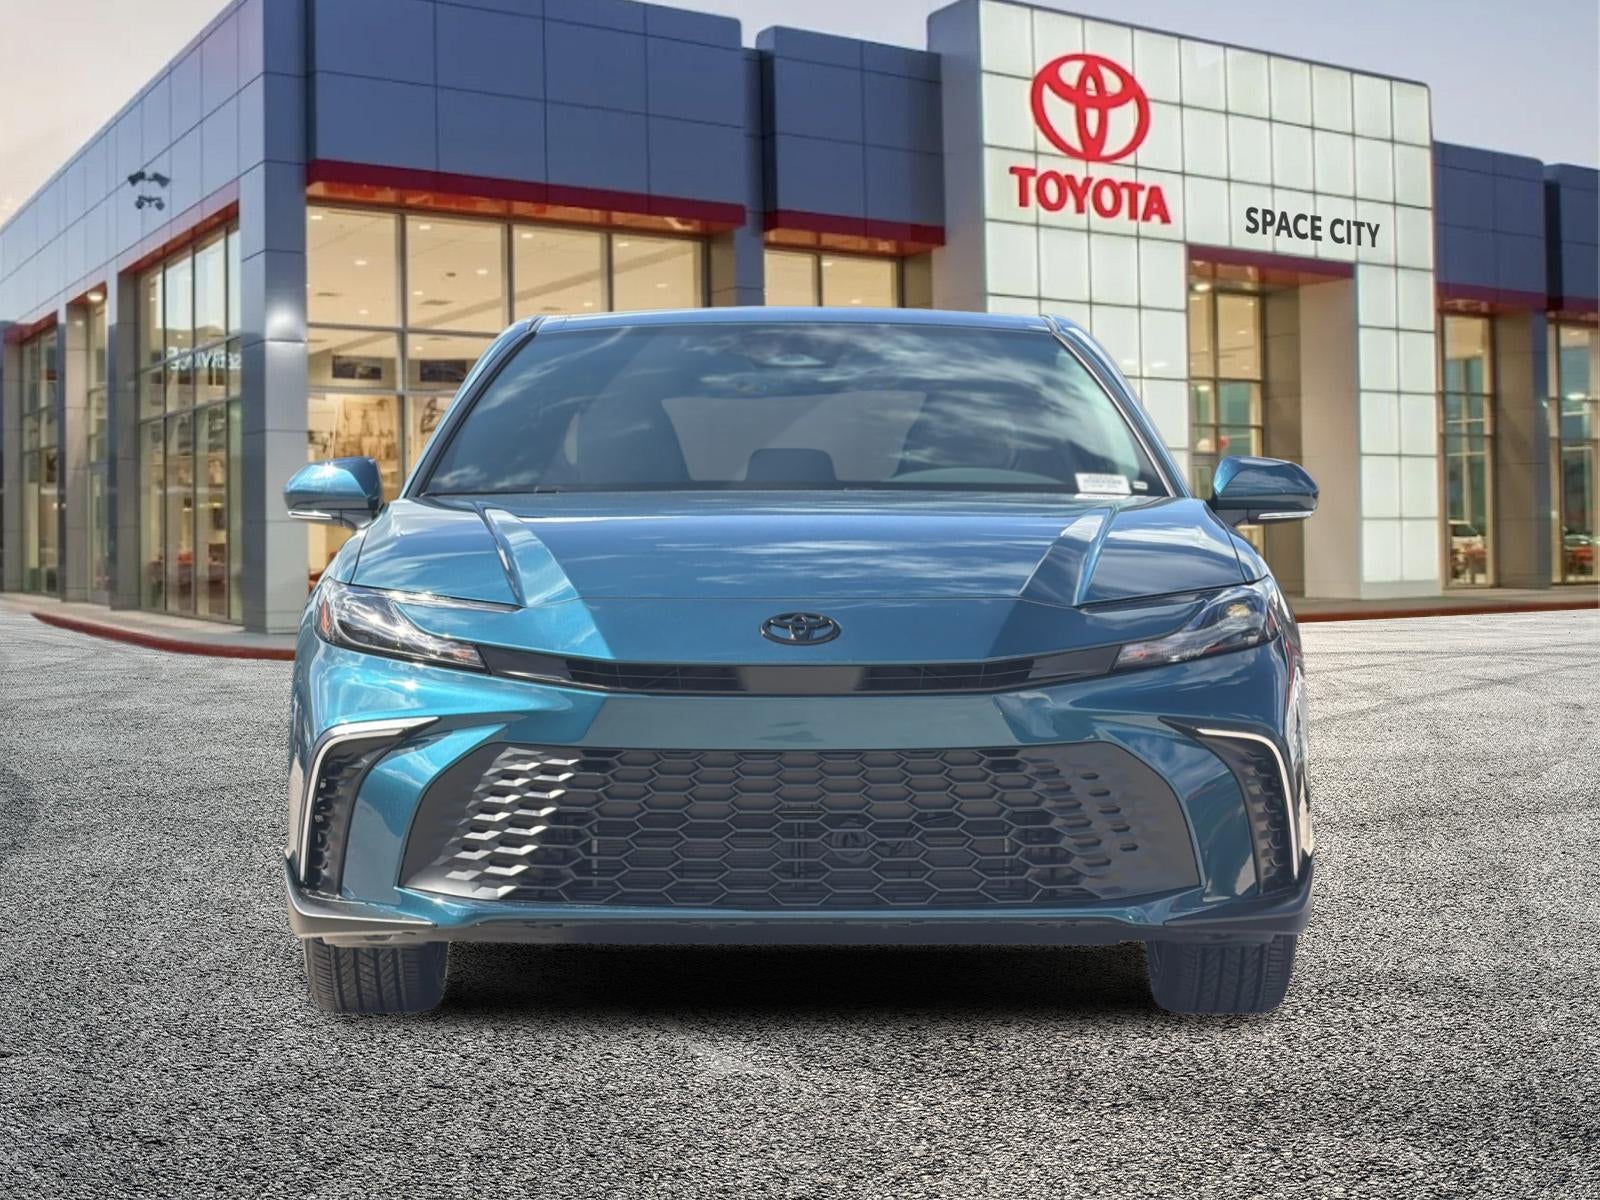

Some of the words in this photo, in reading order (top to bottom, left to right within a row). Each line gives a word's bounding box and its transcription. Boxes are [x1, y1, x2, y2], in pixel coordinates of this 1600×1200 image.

[1009, 167, 1171, 224] TOYOTA
[1245, 207, 1322, 242] SPACE
[1330, 218, 1381, 248] CITY
